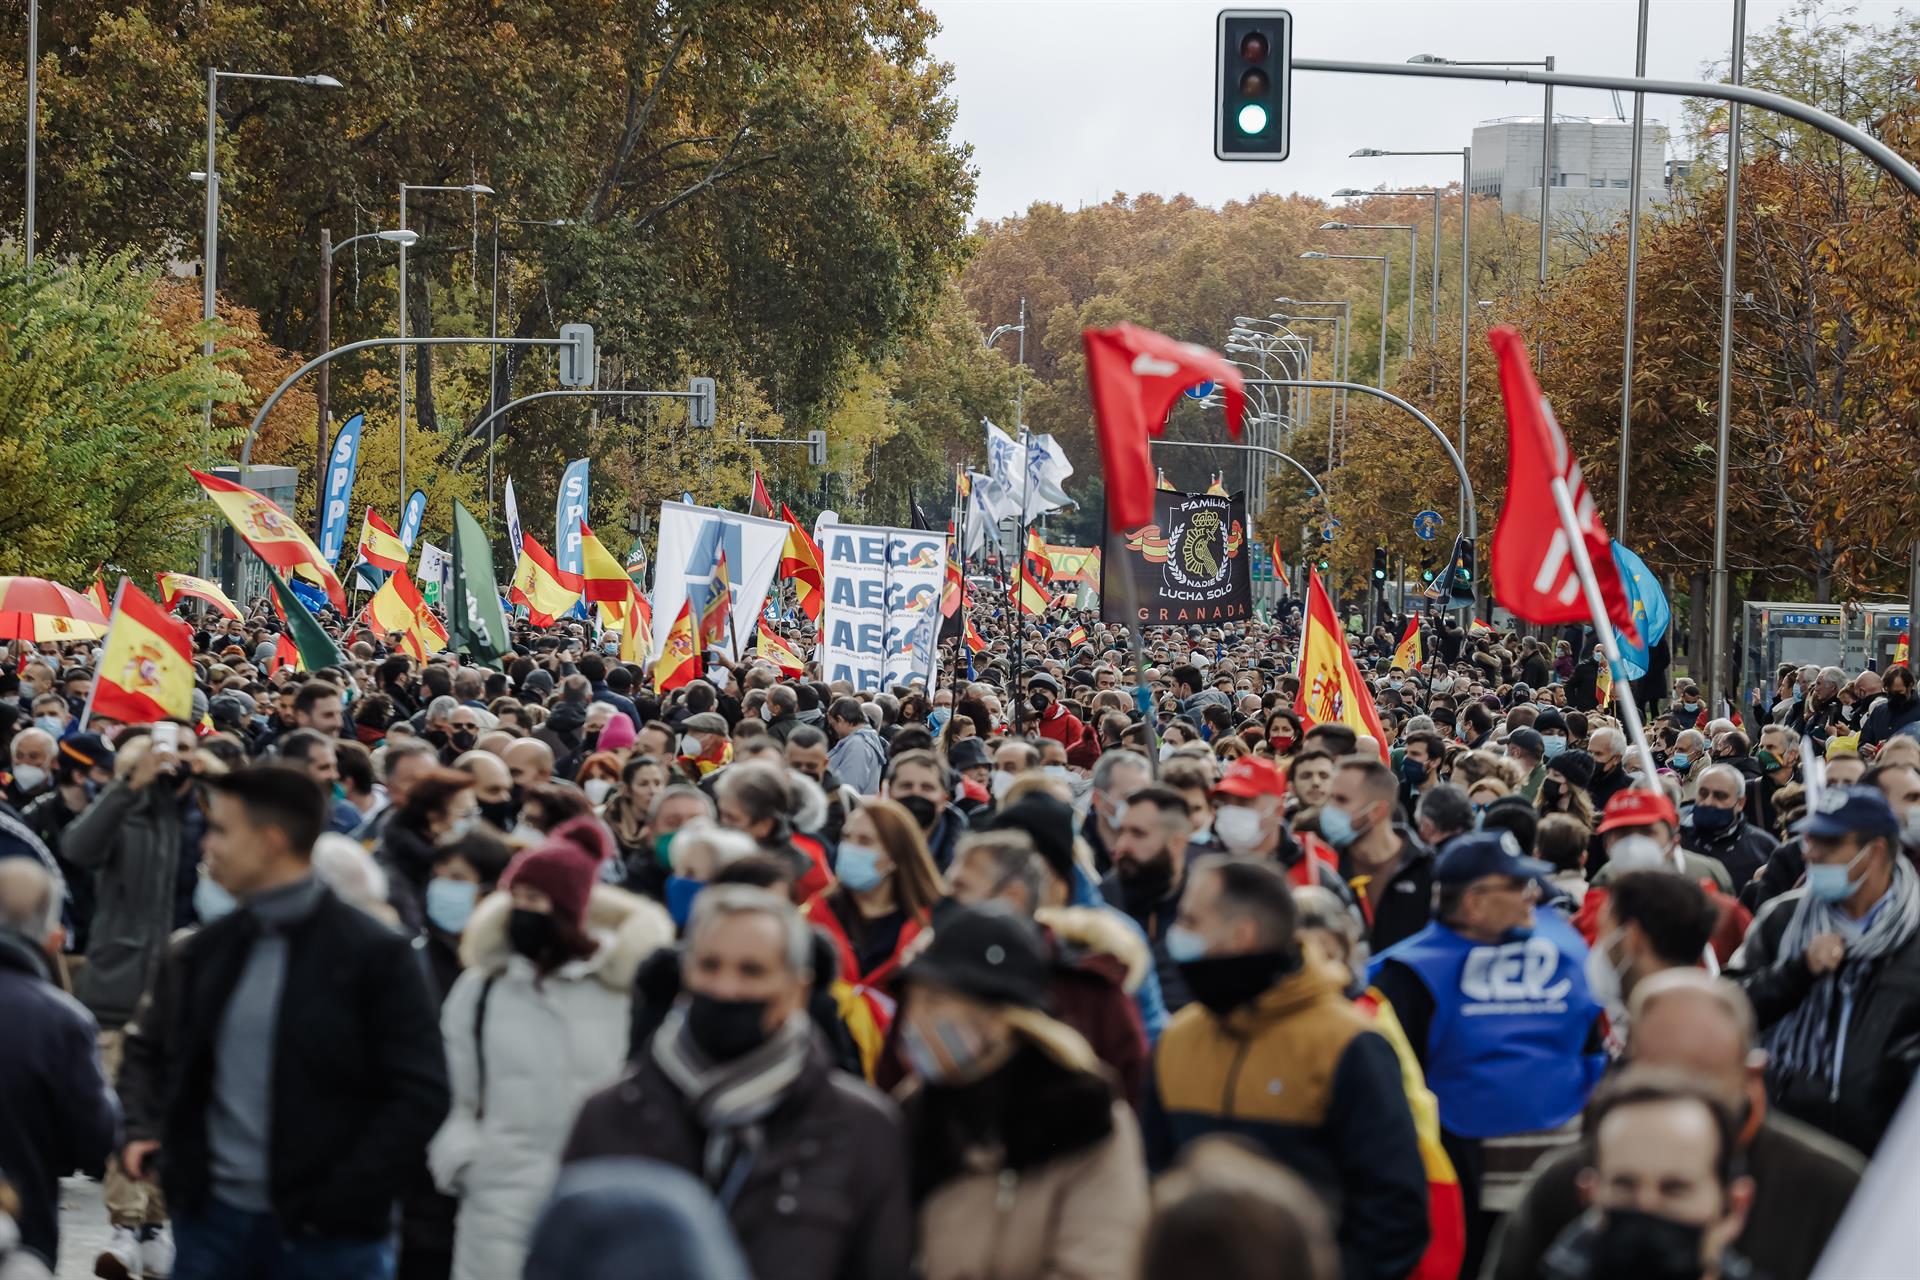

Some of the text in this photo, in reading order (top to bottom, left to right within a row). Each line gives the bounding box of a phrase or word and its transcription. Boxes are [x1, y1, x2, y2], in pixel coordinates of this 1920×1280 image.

[324, 434, 353, 560] SPPL
[1181, 499, 1227, 512] FAMILIA
[830, 535, 940, 569] AEGC
[1049, 552, 1086, 577] VO
[1159, 583, 1232, 600] LUCHA SOLO
[1186, 578, 1216, 588] NADIE
[1138, 603, 1245, 620] GRANADA
